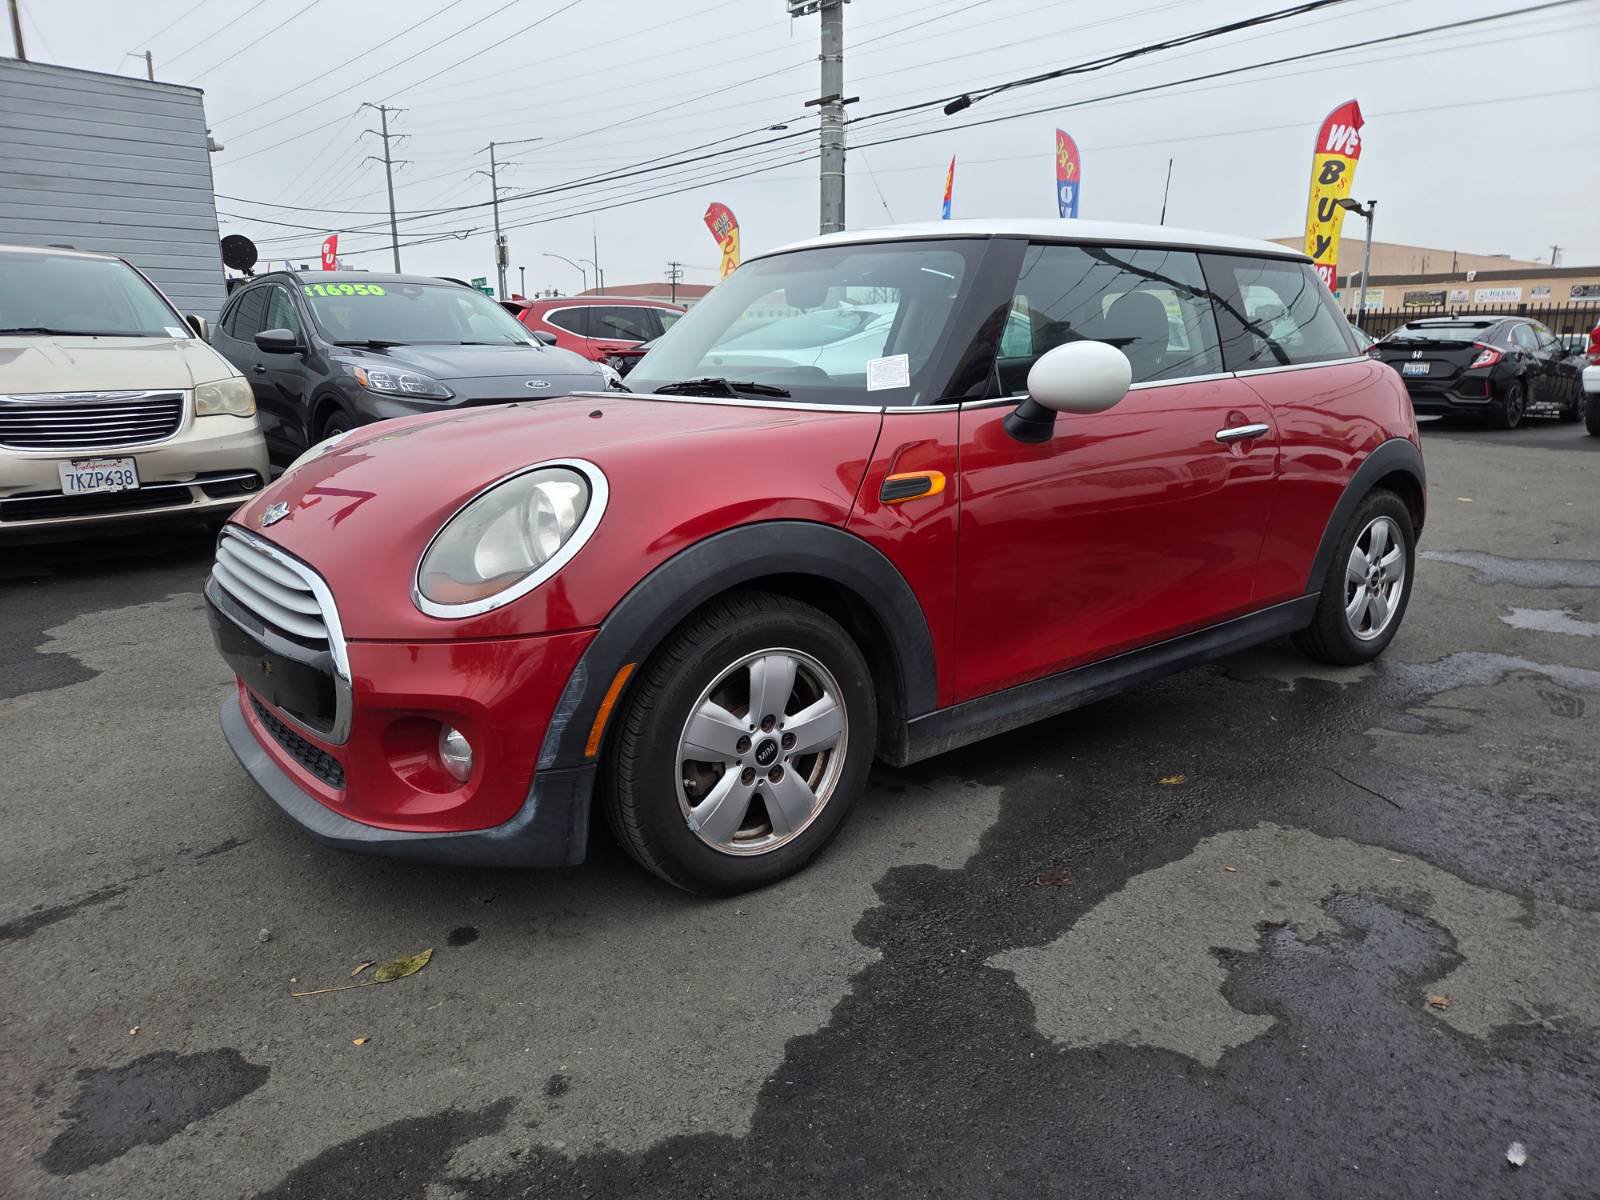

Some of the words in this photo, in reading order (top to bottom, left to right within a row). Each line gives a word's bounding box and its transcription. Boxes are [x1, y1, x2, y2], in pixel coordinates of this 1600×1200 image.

[323, 243, 335, 270] BU
[75, 461, 119, 471] California
[65, 469, 134, 491] 7KZP638
[758, 743, 776, 762] MINI
